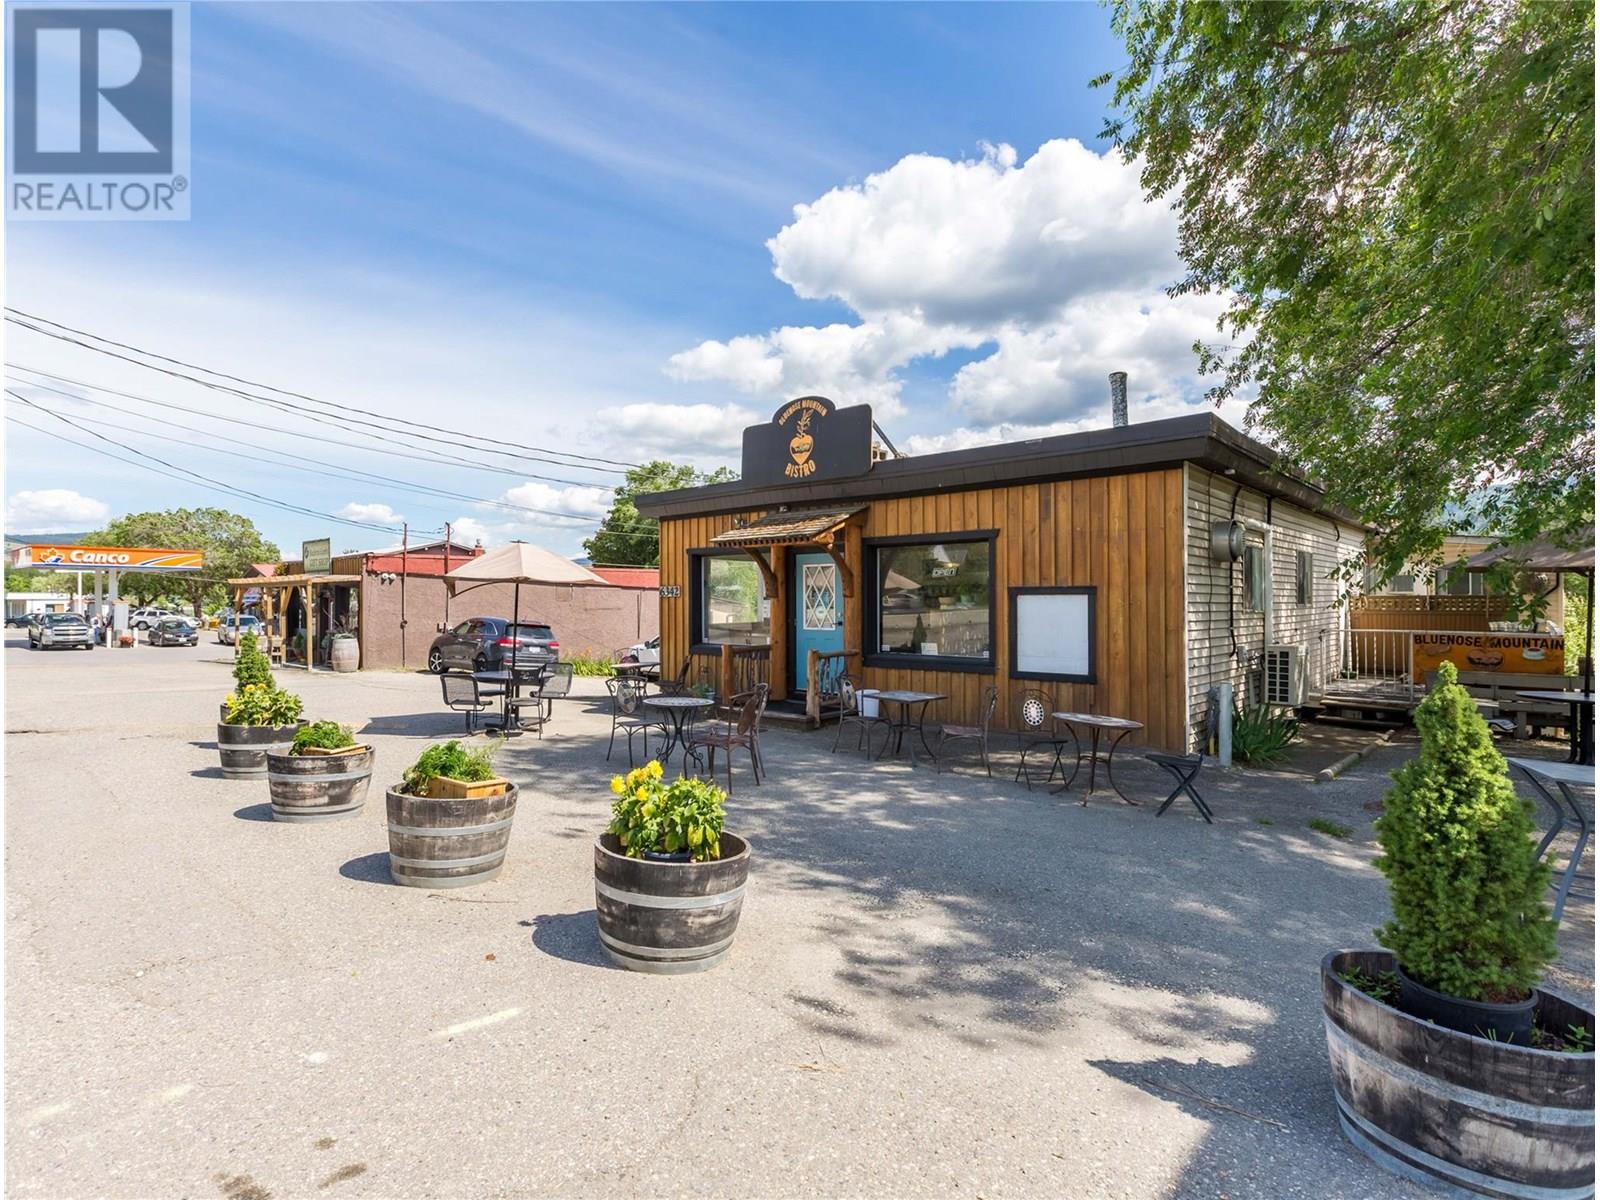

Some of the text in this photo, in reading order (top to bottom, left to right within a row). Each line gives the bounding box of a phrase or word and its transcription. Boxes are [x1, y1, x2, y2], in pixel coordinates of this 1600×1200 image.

[778, 399, 828, 426] BLUENOSE MOUNTAIN
[784, 459, 816, 478] BISTRO
[69, 549, 130, 565] Canco
[1414, 633, 1564, 651] BLUENOSE MOUNTAIN
